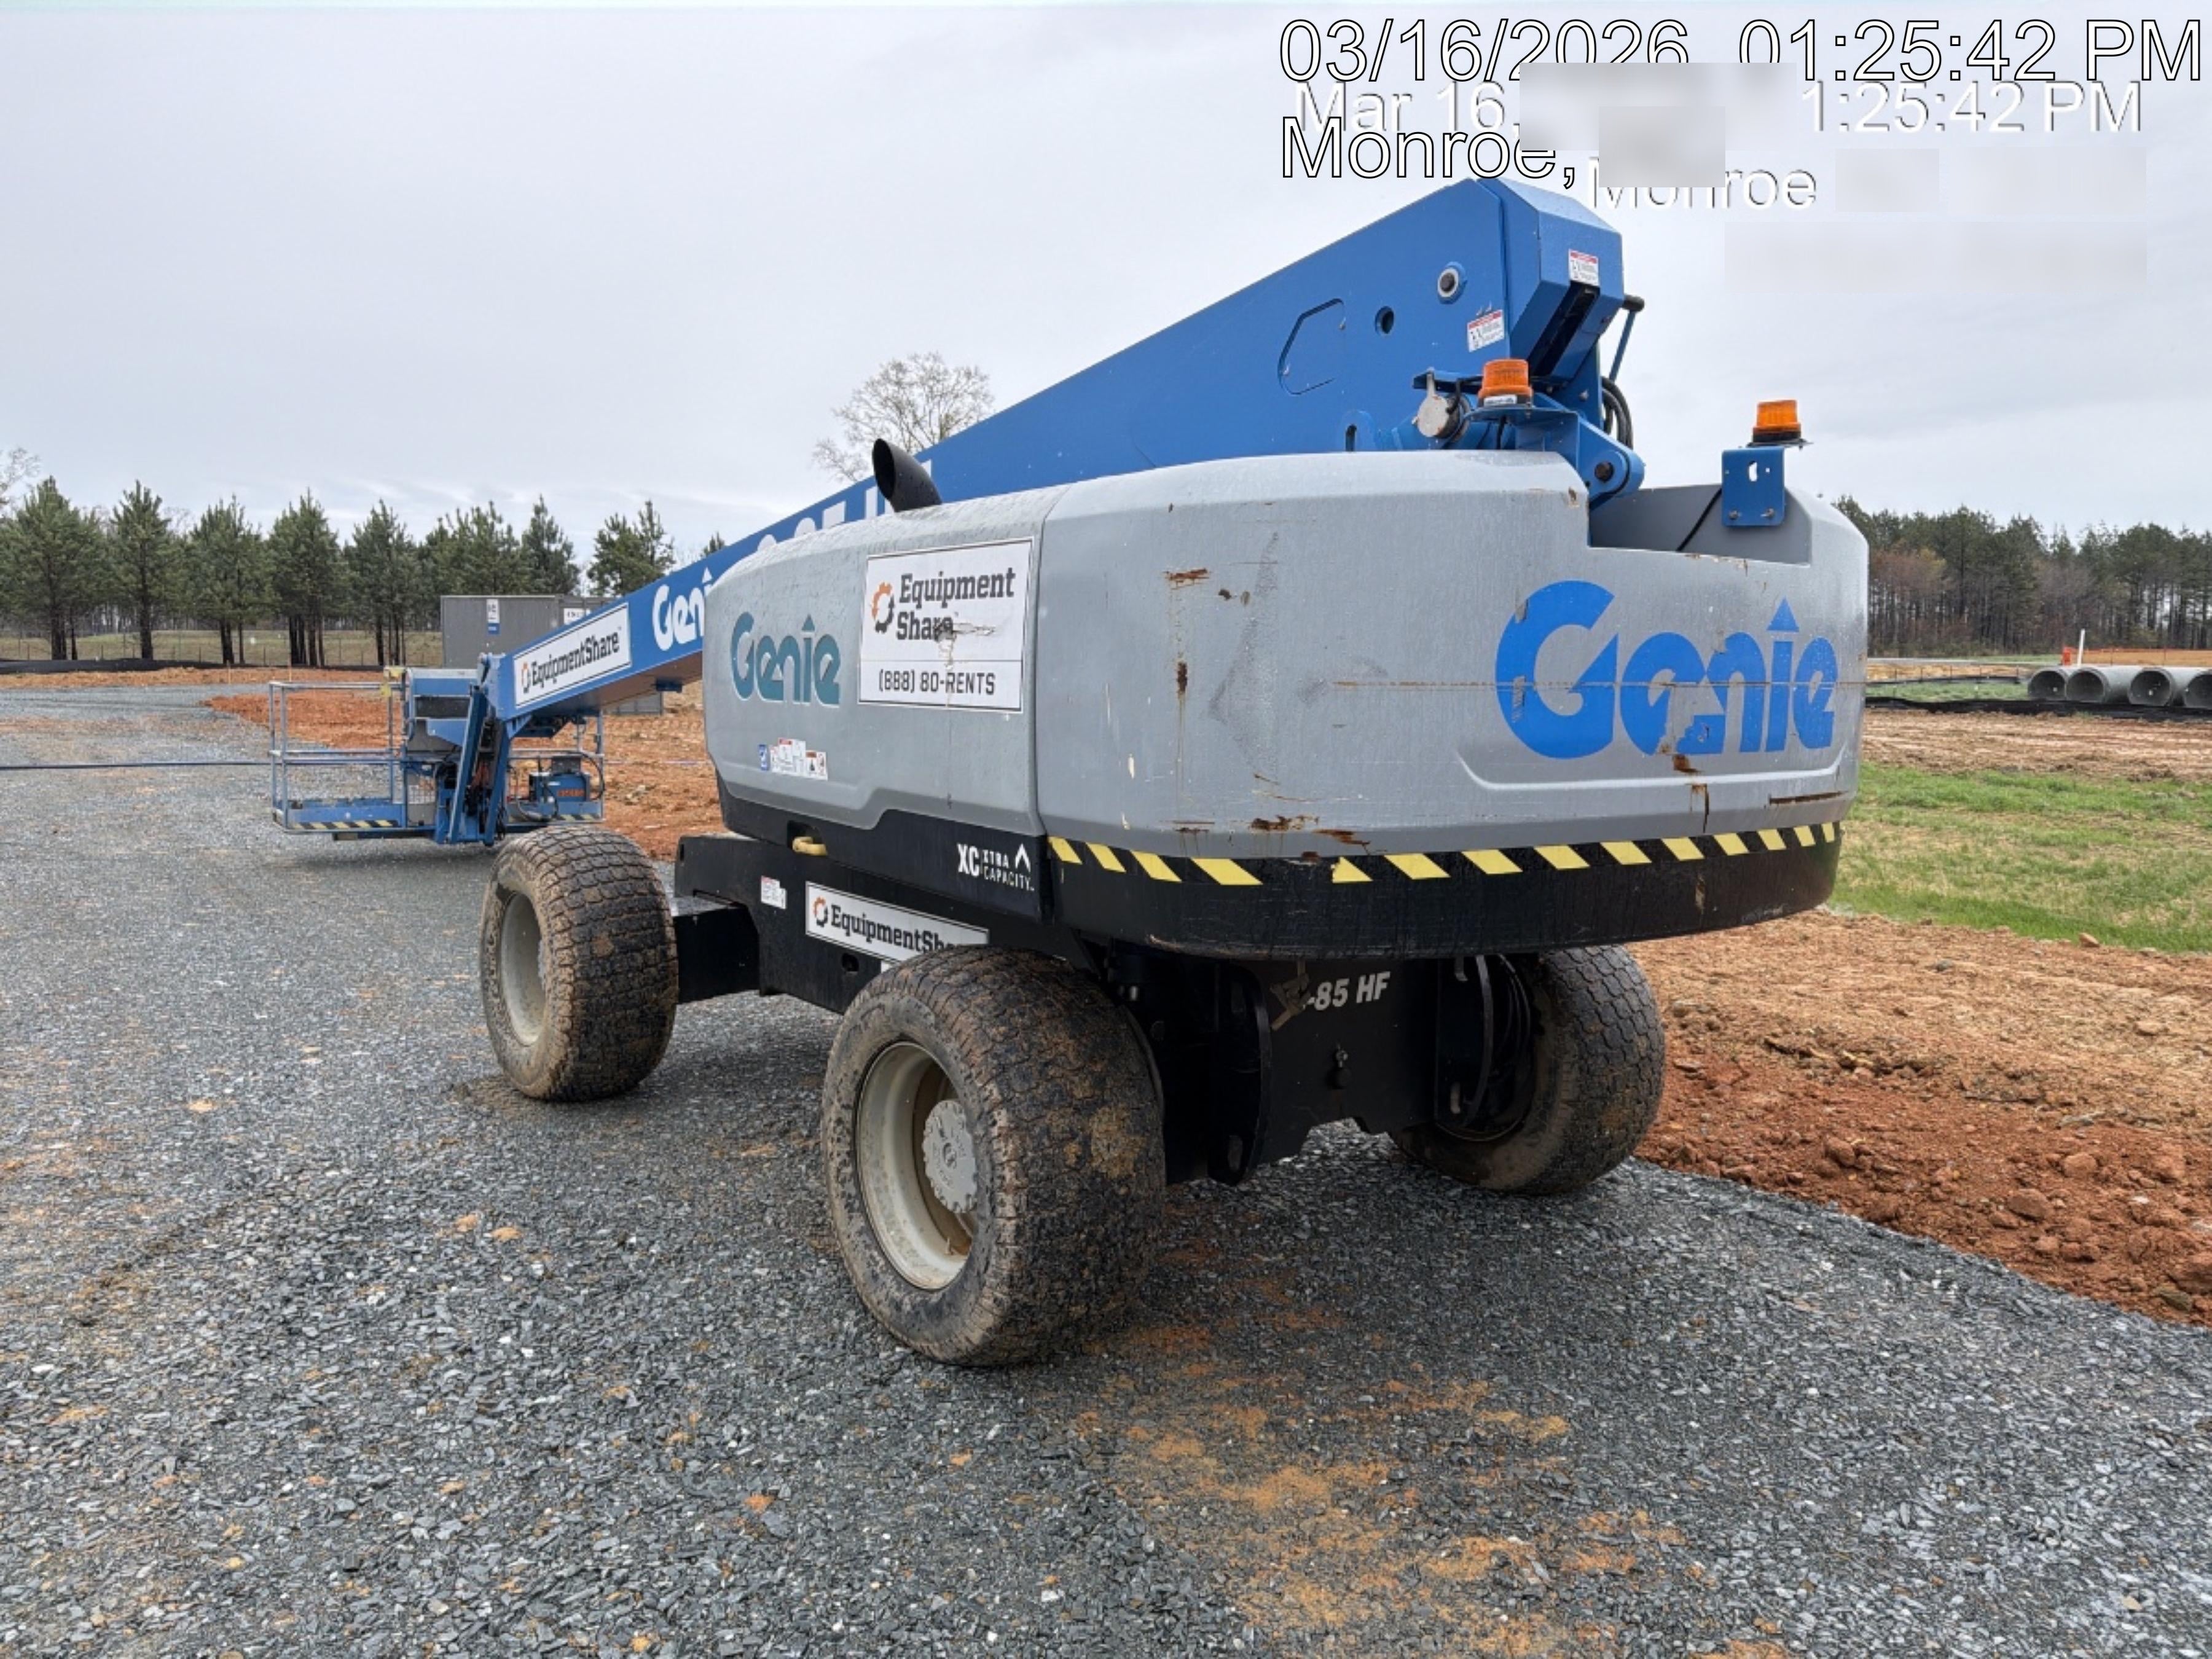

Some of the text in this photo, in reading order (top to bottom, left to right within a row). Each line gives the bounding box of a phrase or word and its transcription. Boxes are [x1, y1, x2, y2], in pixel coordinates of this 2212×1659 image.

[898, 568, 1016, 609] Equipment
[896, 611, 955, 641] Share
[531, 631, 620, 688] EquipmentShare
[731, 611, 841, 707] Genie
[1495, 580, 1838, 759] Genie
[879, 669, 996, 696] (888) 80-RENTS
[957, 842, 980, 877] XC
[982, 849, 1010, 869] XTRA
[831, 904, 955, 953] EquipmentSh
[1355, 971, 1391, 1004] HF
